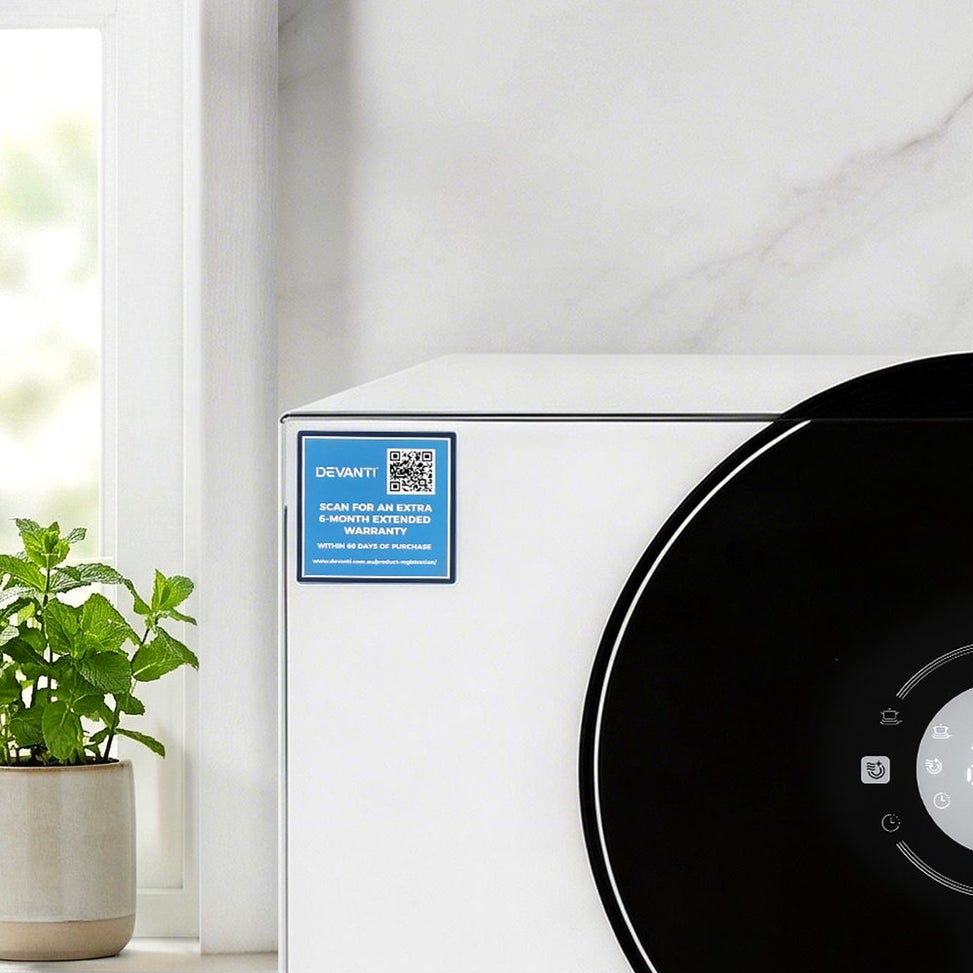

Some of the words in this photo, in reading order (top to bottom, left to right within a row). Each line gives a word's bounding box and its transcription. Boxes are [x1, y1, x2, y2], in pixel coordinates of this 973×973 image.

[316, 467, 377, 478] DEVANTI
[320, 503, 349, 511] SCAN
[352, 503, 374, 511] FOR
[378, 504, 393, 512] AN
[397, 504, 432, 512] EXTRA
[319, 515, 369, 523] 6-MONTH
[373, 515, 431, 524] EXTENDED
[344, 527, 407, 535] WARRANTY
